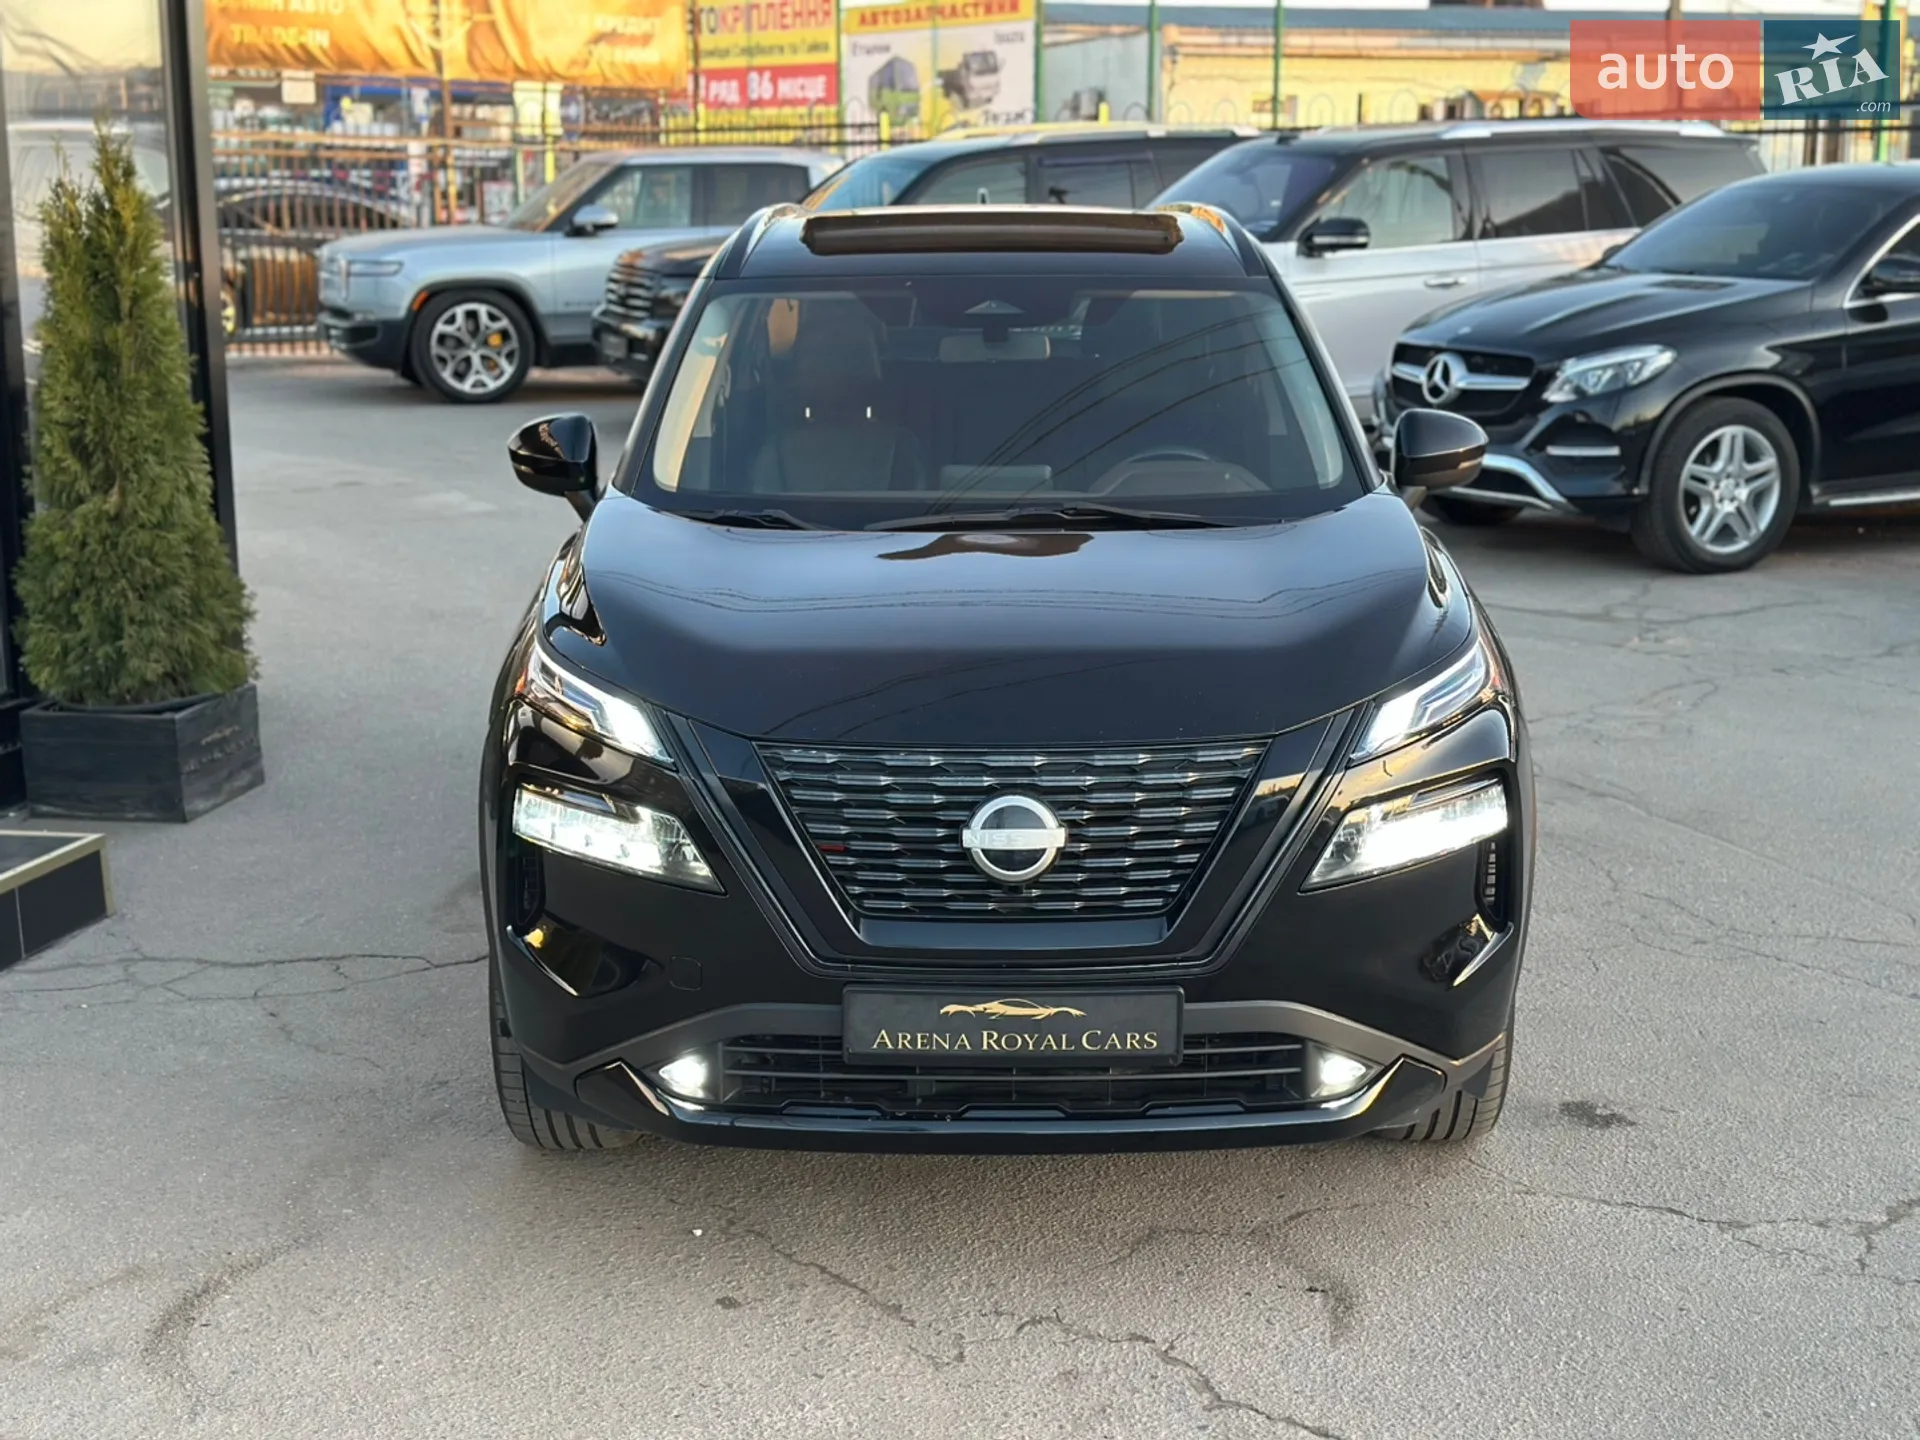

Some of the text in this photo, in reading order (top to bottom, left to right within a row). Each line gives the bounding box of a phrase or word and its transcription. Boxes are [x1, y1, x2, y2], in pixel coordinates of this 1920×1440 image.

[871, 1029, 1158, 1051] ARENA ROYAL CARS
